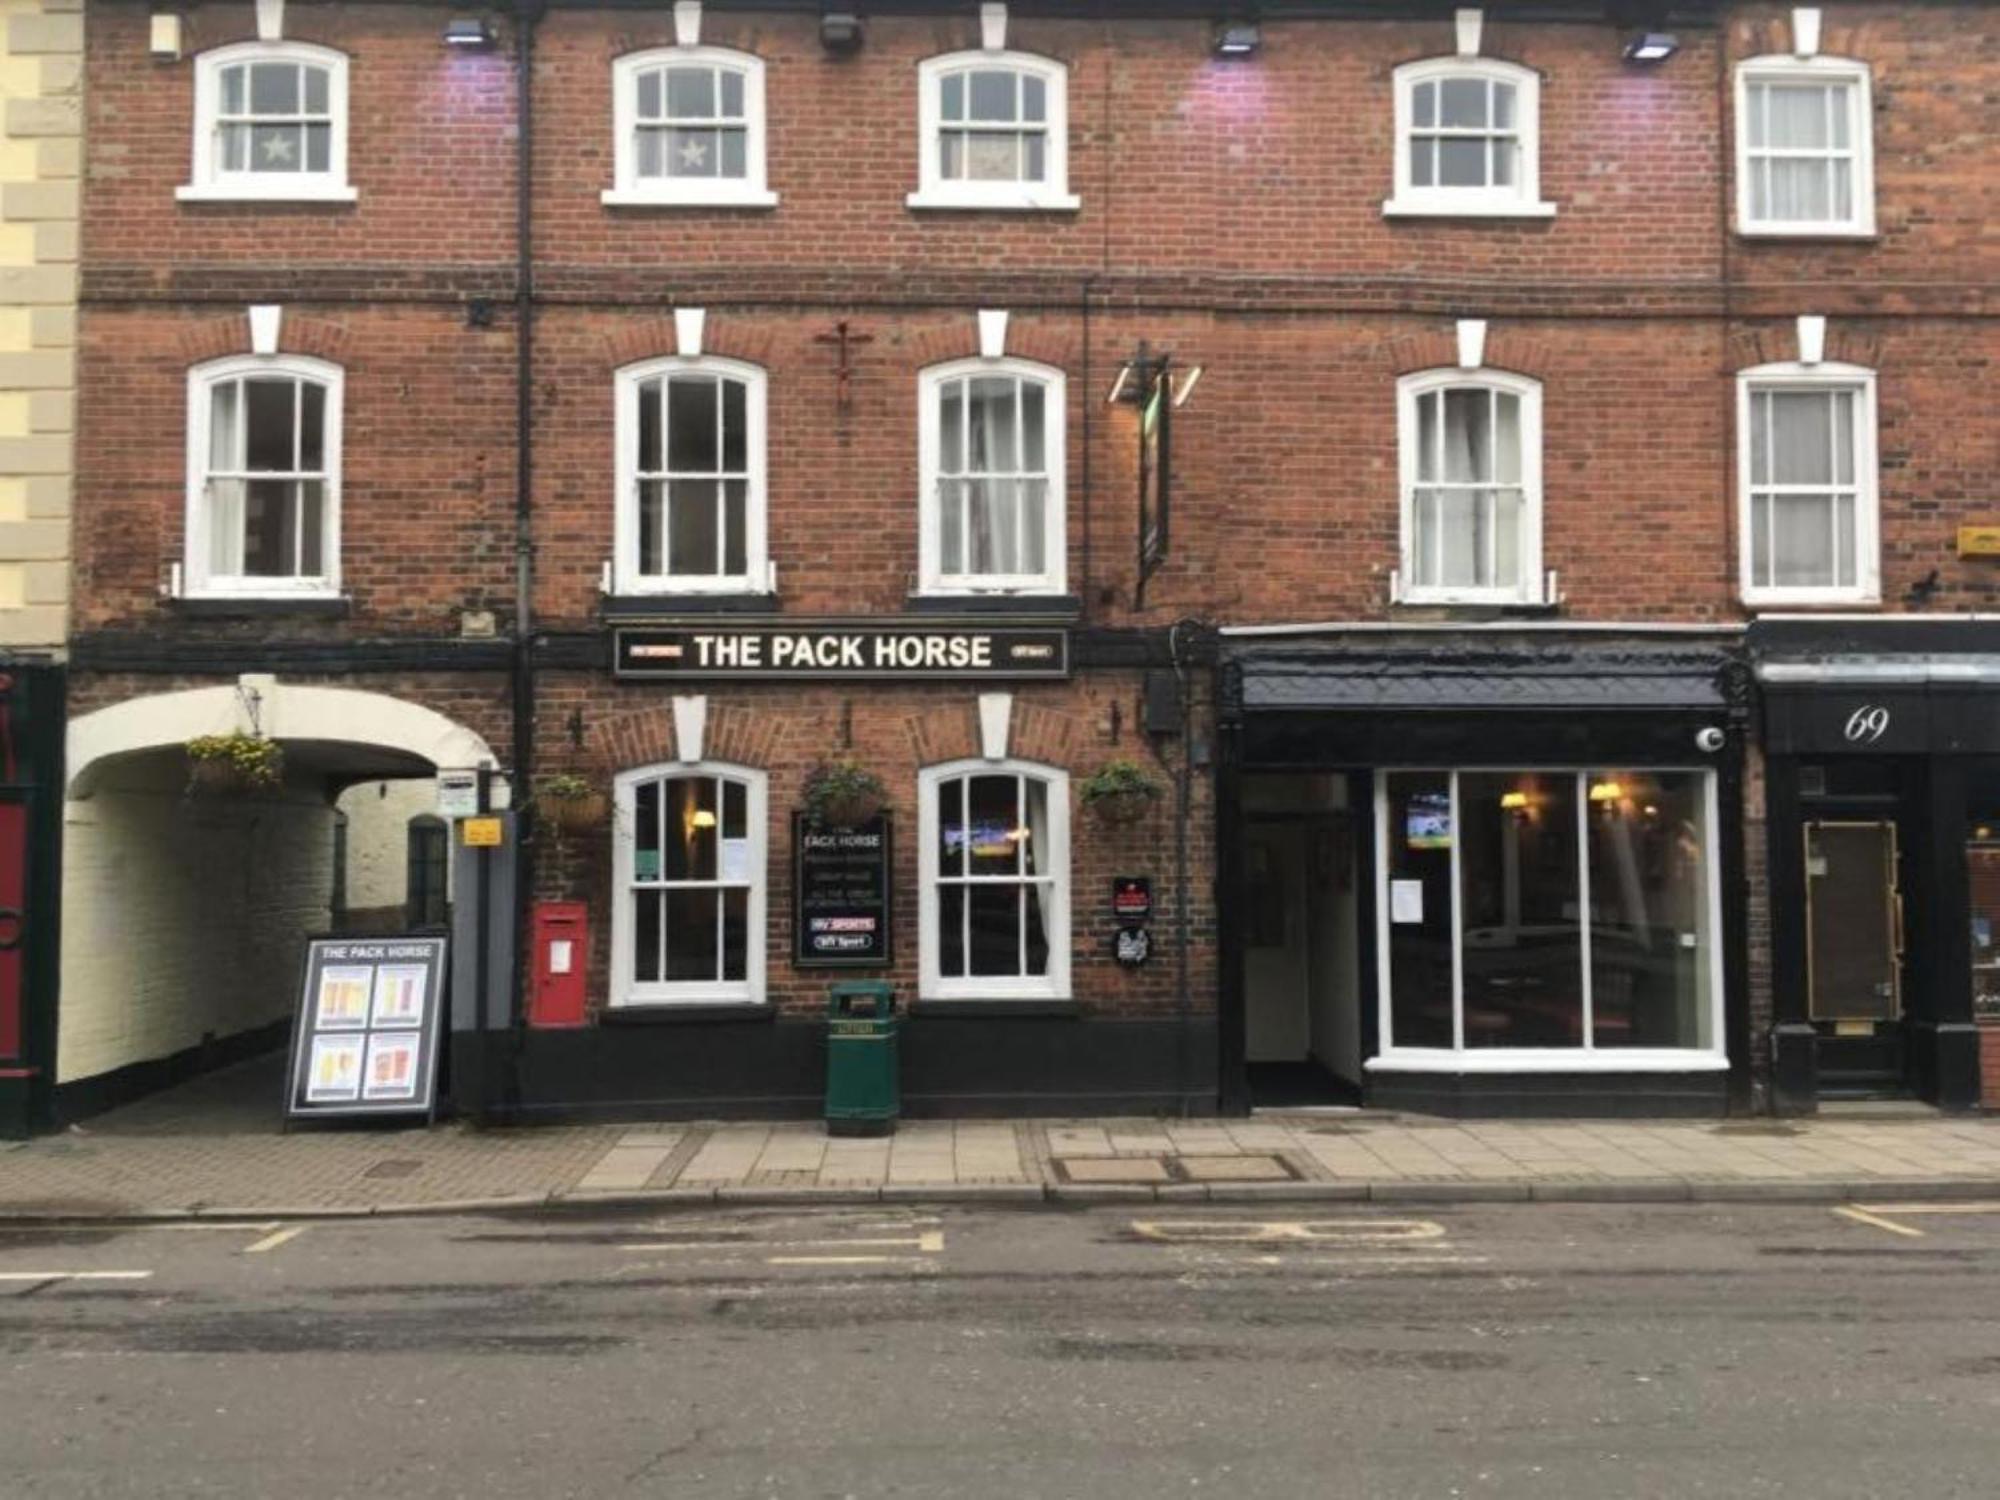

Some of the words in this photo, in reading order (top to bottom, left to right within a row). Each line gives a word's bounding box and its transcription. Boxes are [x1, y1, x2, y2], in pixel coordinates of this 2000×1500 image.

[694, 636, 761, 666] THE
[772, 636, 864, 666] PACK
[875, 636, 991, 666] HORSE
[1844, 705, 1889, 743] 69
[839, 834, 880, 848] HORSE
[323, 946, 347, 959] THE
[350, 945, 384, 958] PACK
[388, 944, 432, 958] HORSE
